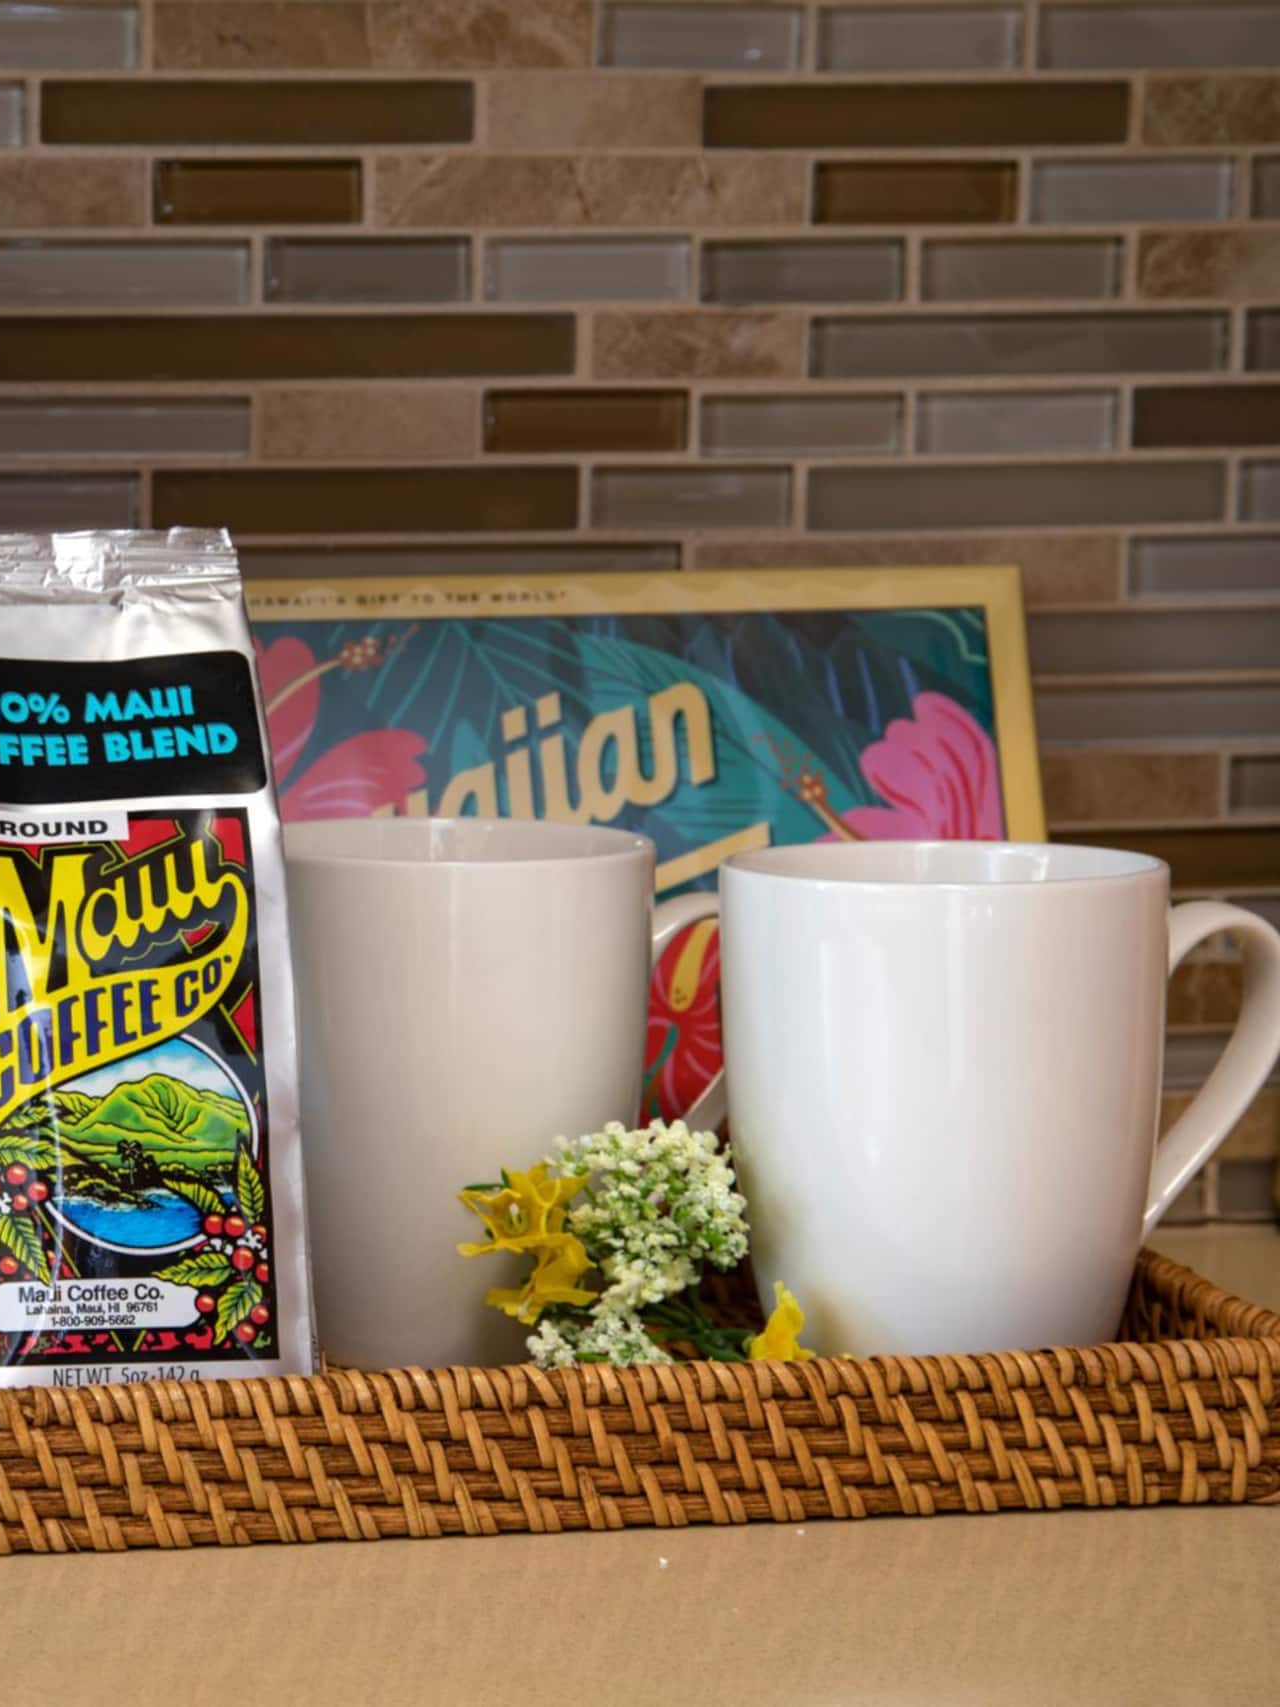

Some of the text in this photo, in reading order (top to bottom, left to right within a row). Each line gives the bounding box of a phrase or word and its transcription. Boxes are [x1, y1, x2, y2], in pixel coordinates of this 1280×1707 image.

[84, 685, 195, 722] MAUI
[105, 724, 238, 763] BLEND
[18, 1283, 165, 1302] Maui Coffee Co.
[76, 1302, 106, 1315] Maui,
[108, 1302, 120, 1313] HI
[126, 1301, 158, 1313] 96761
[53, 1367, 84, 1388] NET
[86, 1366, 112, 1385] WT
